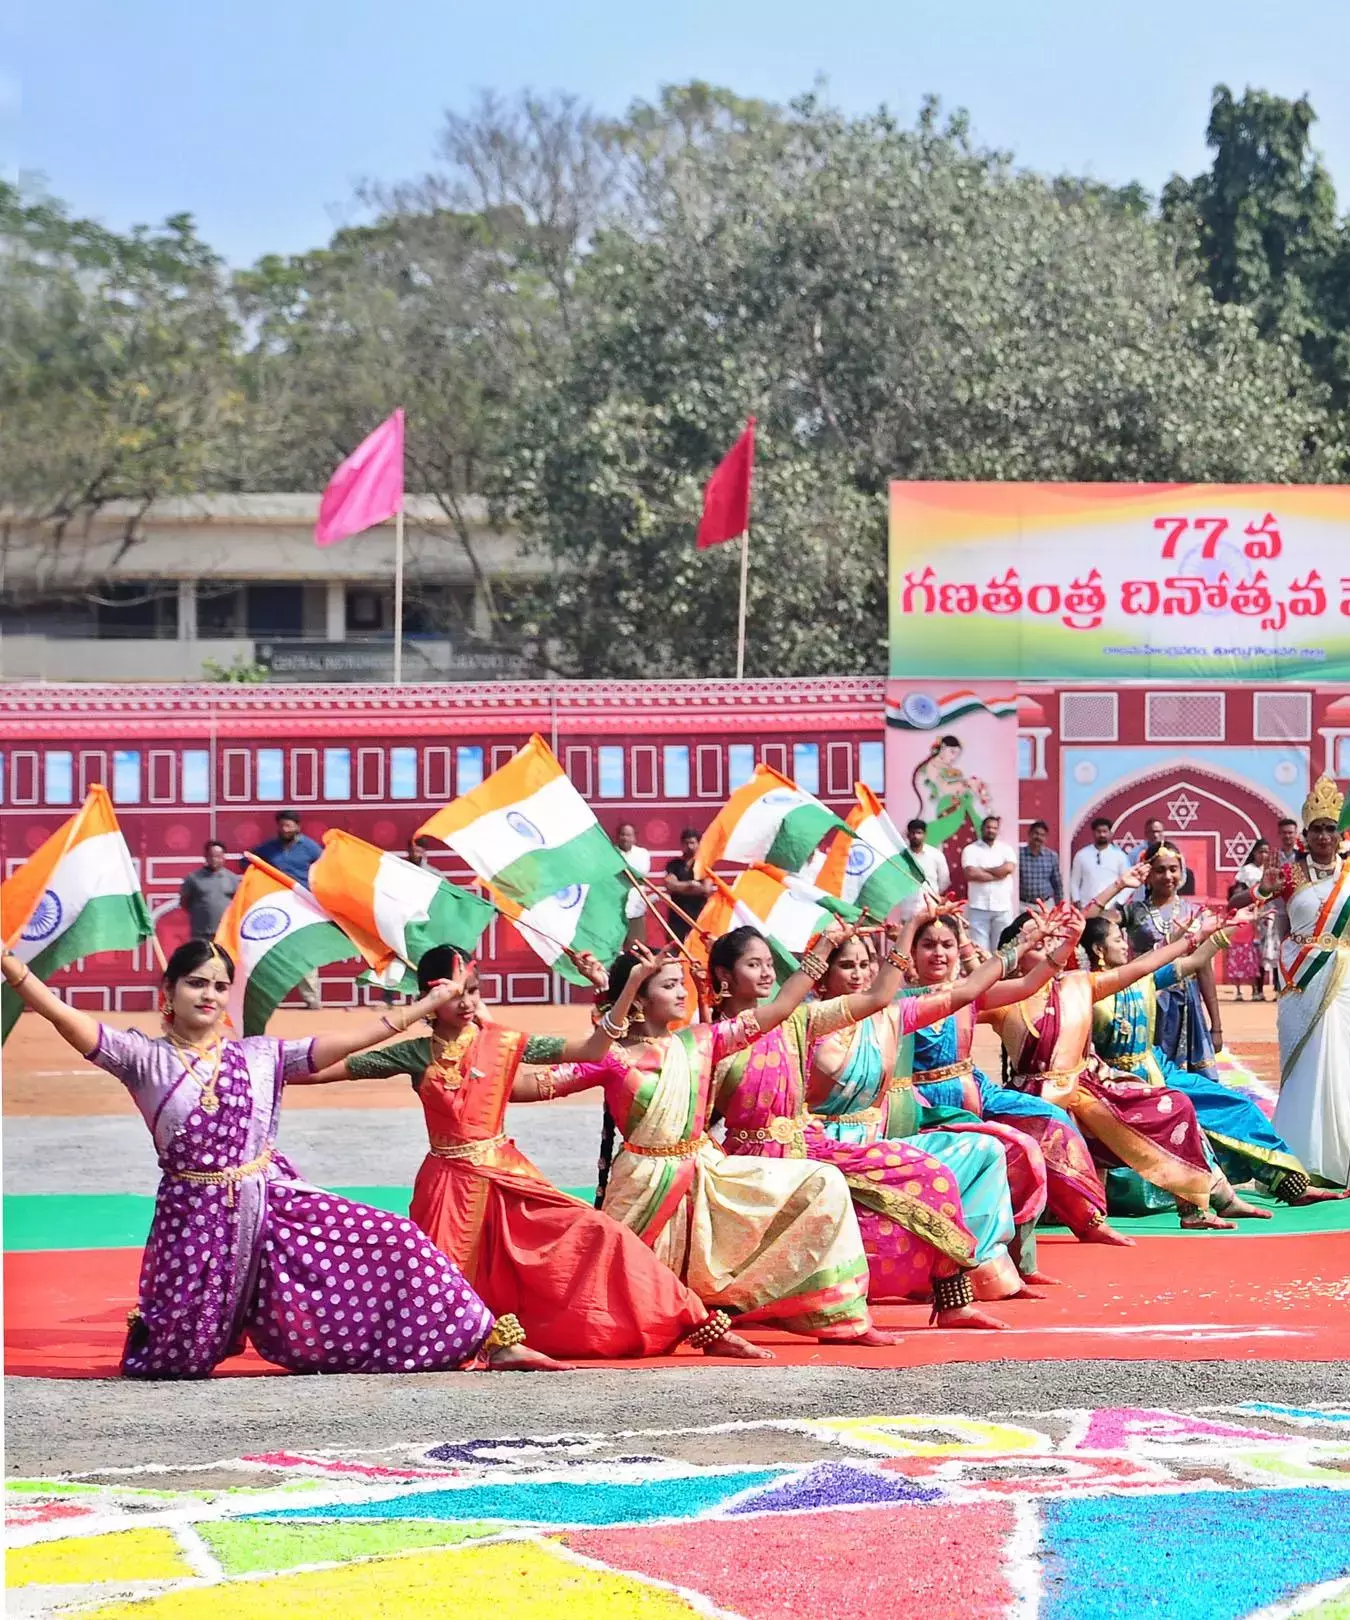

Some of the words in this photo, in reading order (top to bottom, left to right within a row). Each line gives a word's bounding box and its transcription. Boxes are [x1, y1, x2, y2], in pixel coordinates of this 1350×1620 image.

[1153, 517, 1229, 559] 77
[1243, 512, 1282, 559] వ
[901, 566, 1106, 629] గణతంత్ర
[1121, 569, 1327, 630] దినోత్సవ
